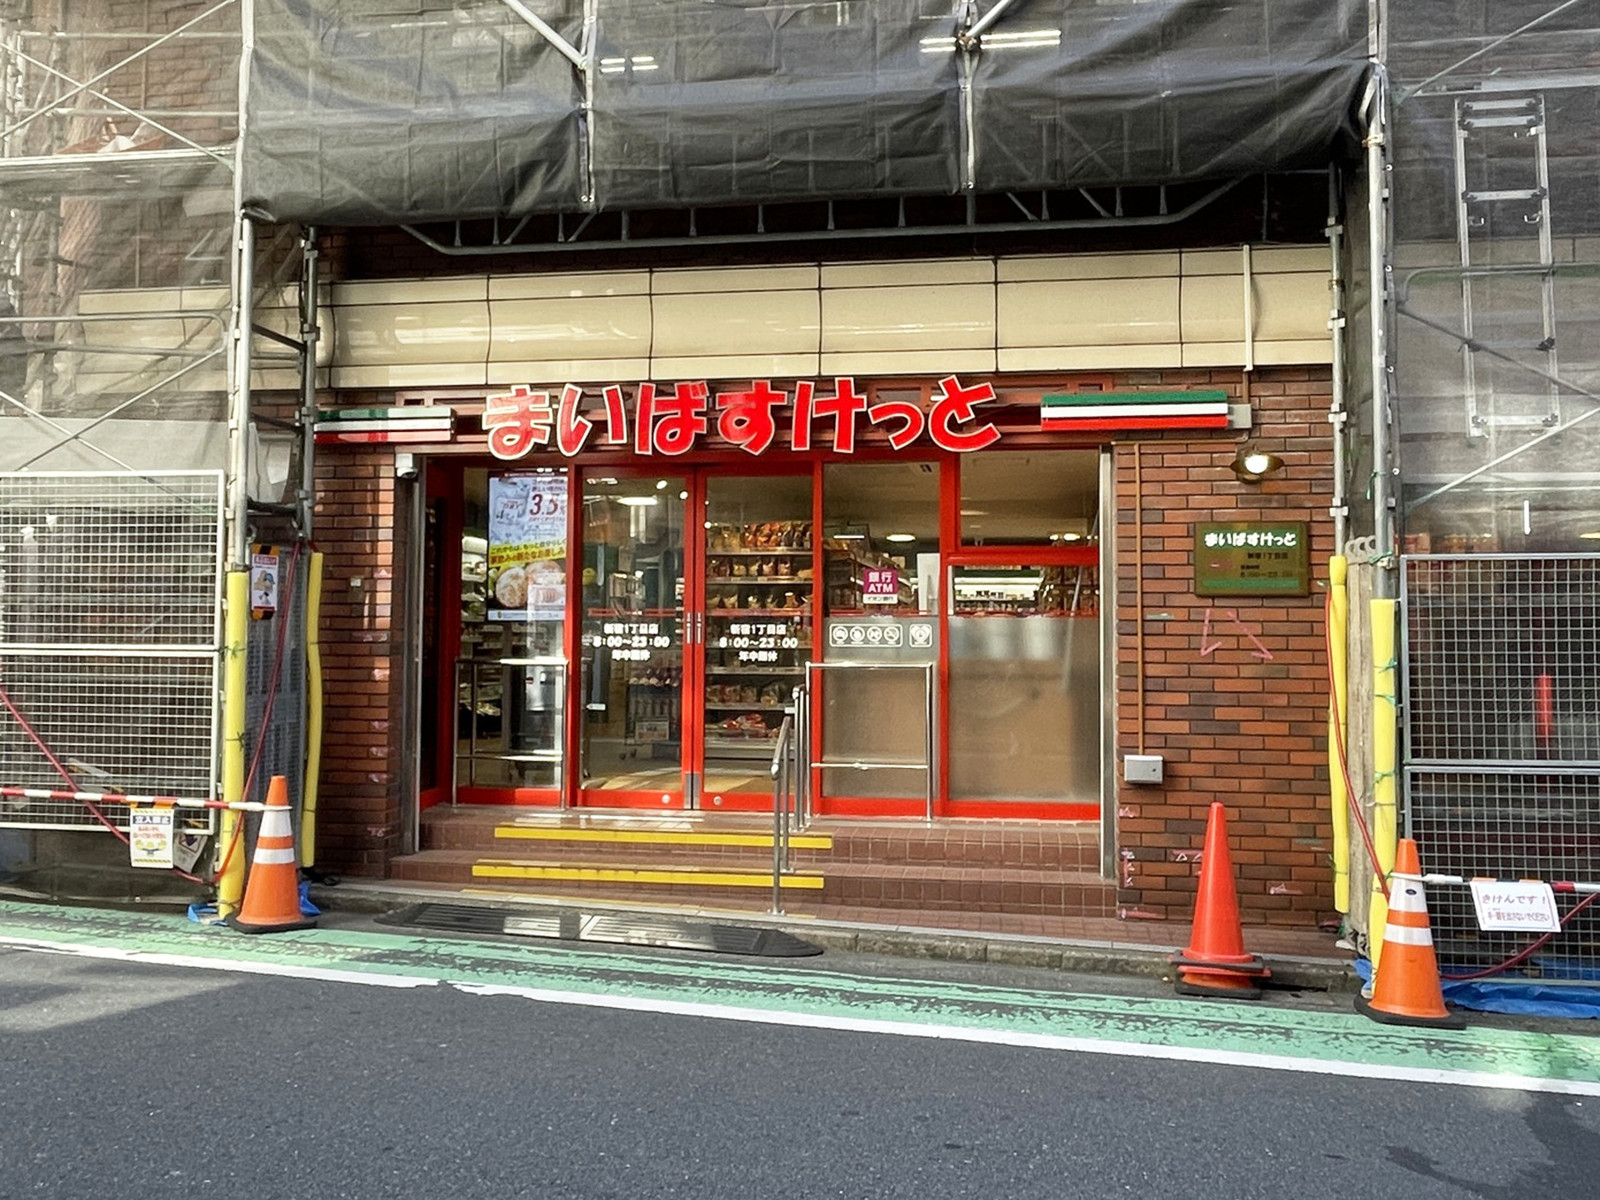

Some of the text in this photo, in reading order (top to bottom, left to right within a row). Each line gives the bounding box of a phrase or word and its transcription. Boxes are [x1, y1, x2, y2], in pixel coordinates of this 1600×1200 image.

[481, 374, 1001, 460] まいばすけっと
[1204, 532, 1297, 547] まいばすけっと
[868, 571, 897, 583] 銀行
[868, 583, 898, 593] ATM
[611, 649, 650, 661] 年中無休
[738, 650, 778, 662] 年中無休
